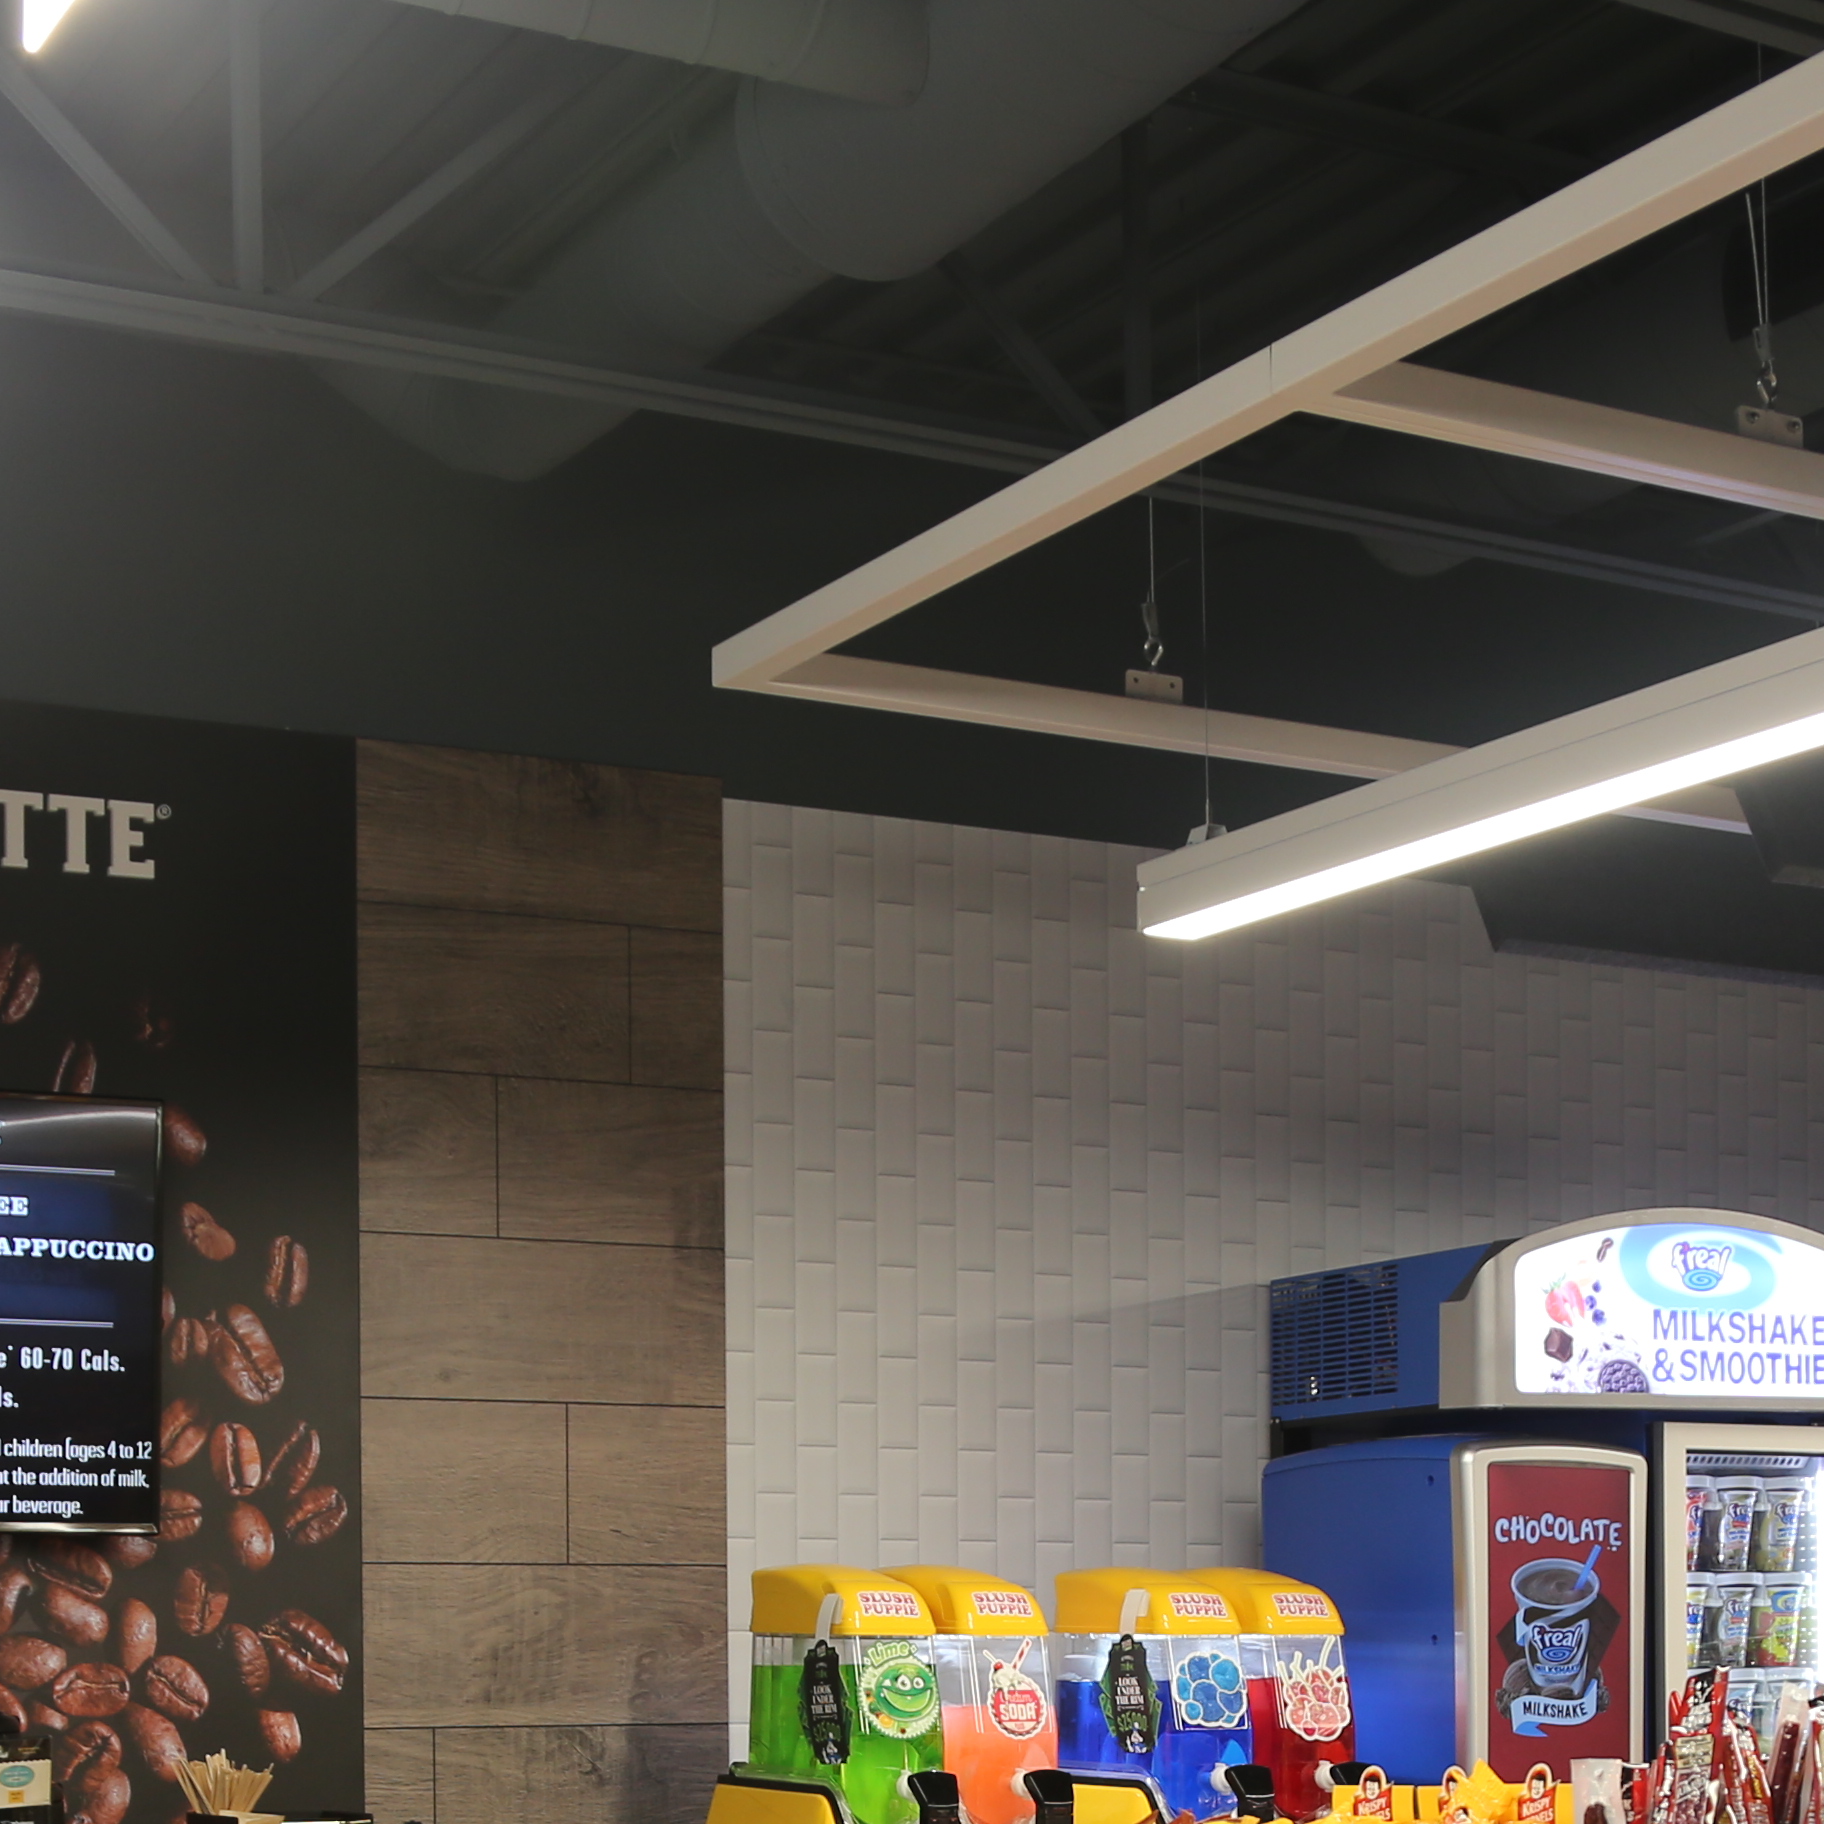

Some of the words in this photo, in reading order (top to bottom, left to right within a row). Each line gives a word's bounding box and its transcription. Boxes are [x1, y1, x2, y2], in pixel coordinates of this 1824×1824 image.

[20, 1347, 73, 1370] 60-70
[81, 1348, 125, 1372] Cals.
[4, 1438, 63, 1458] children
[65, 1437, 105, 1461] (ages
[107, 1441, 116, 1458] 4
[118, 1442, 134, 1459] to
[136, 1441, 152, 1459] 12
[12, 1467, 36, 1486] the
[39, 1468, 98, 1486] addition
[101, 1469, 116, 1486] of
[12, 1495, 83, 1518] beverage.
[1495, 1513, 1623, 1546] CHOCOLATE
[859, 1592, 914, 1604] SLUSH
[973, 1592, 1028, 1604] SLUSH
[1170, 1594, 1222, 1606] SLUSH
[869, 1641, 910, 1663] Lime
[1000, 1703, 1037, 1721] SODA
[1523, 1701, 1588, 1719] MILKSHAKE
